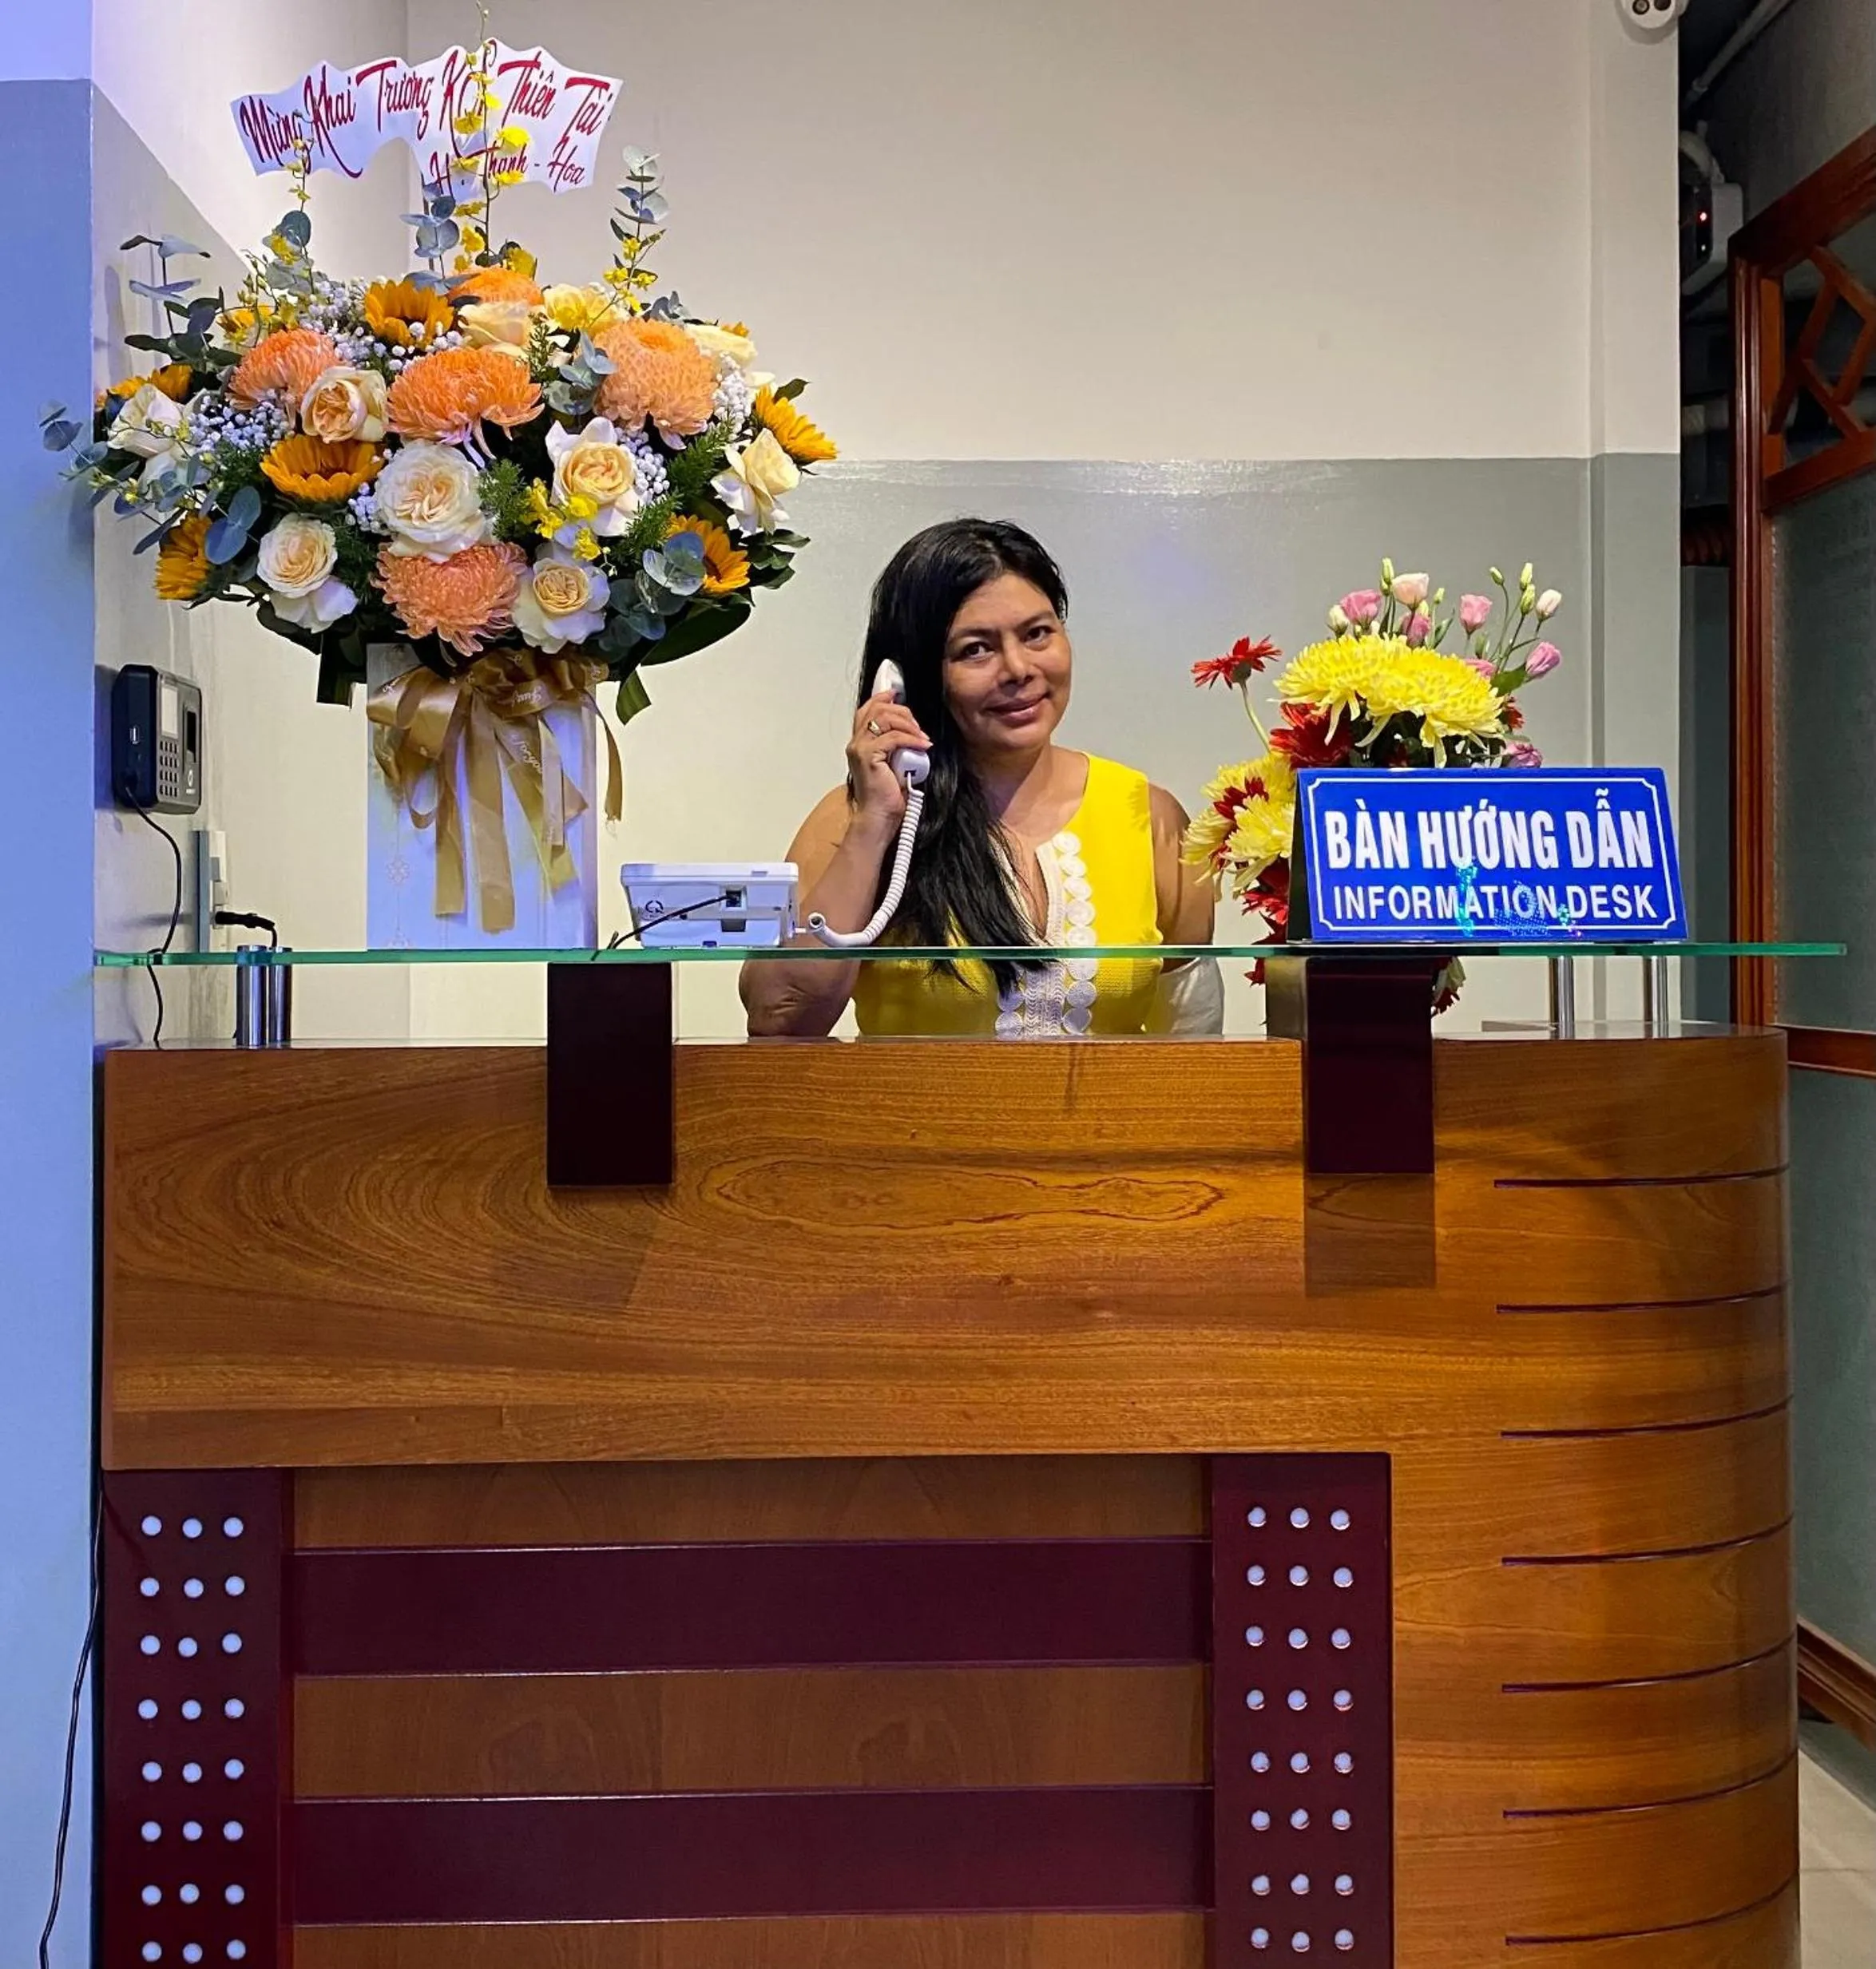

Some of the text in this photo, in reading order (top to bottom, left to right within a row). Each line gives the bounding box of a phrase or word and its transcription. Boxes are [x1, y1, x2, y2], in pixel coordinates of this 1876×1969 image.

[303, 65, 363, 179] Khai
[498, 50, 557, 129] Thiên
[564, 77, 613, 137] Tài
[547, 134, 585, 193] Hoa
[1325, 788, 1653, 869] BÀN HƯỚNG DẪN
[1333, 885, 1658, 920] INFORMATION DESK
